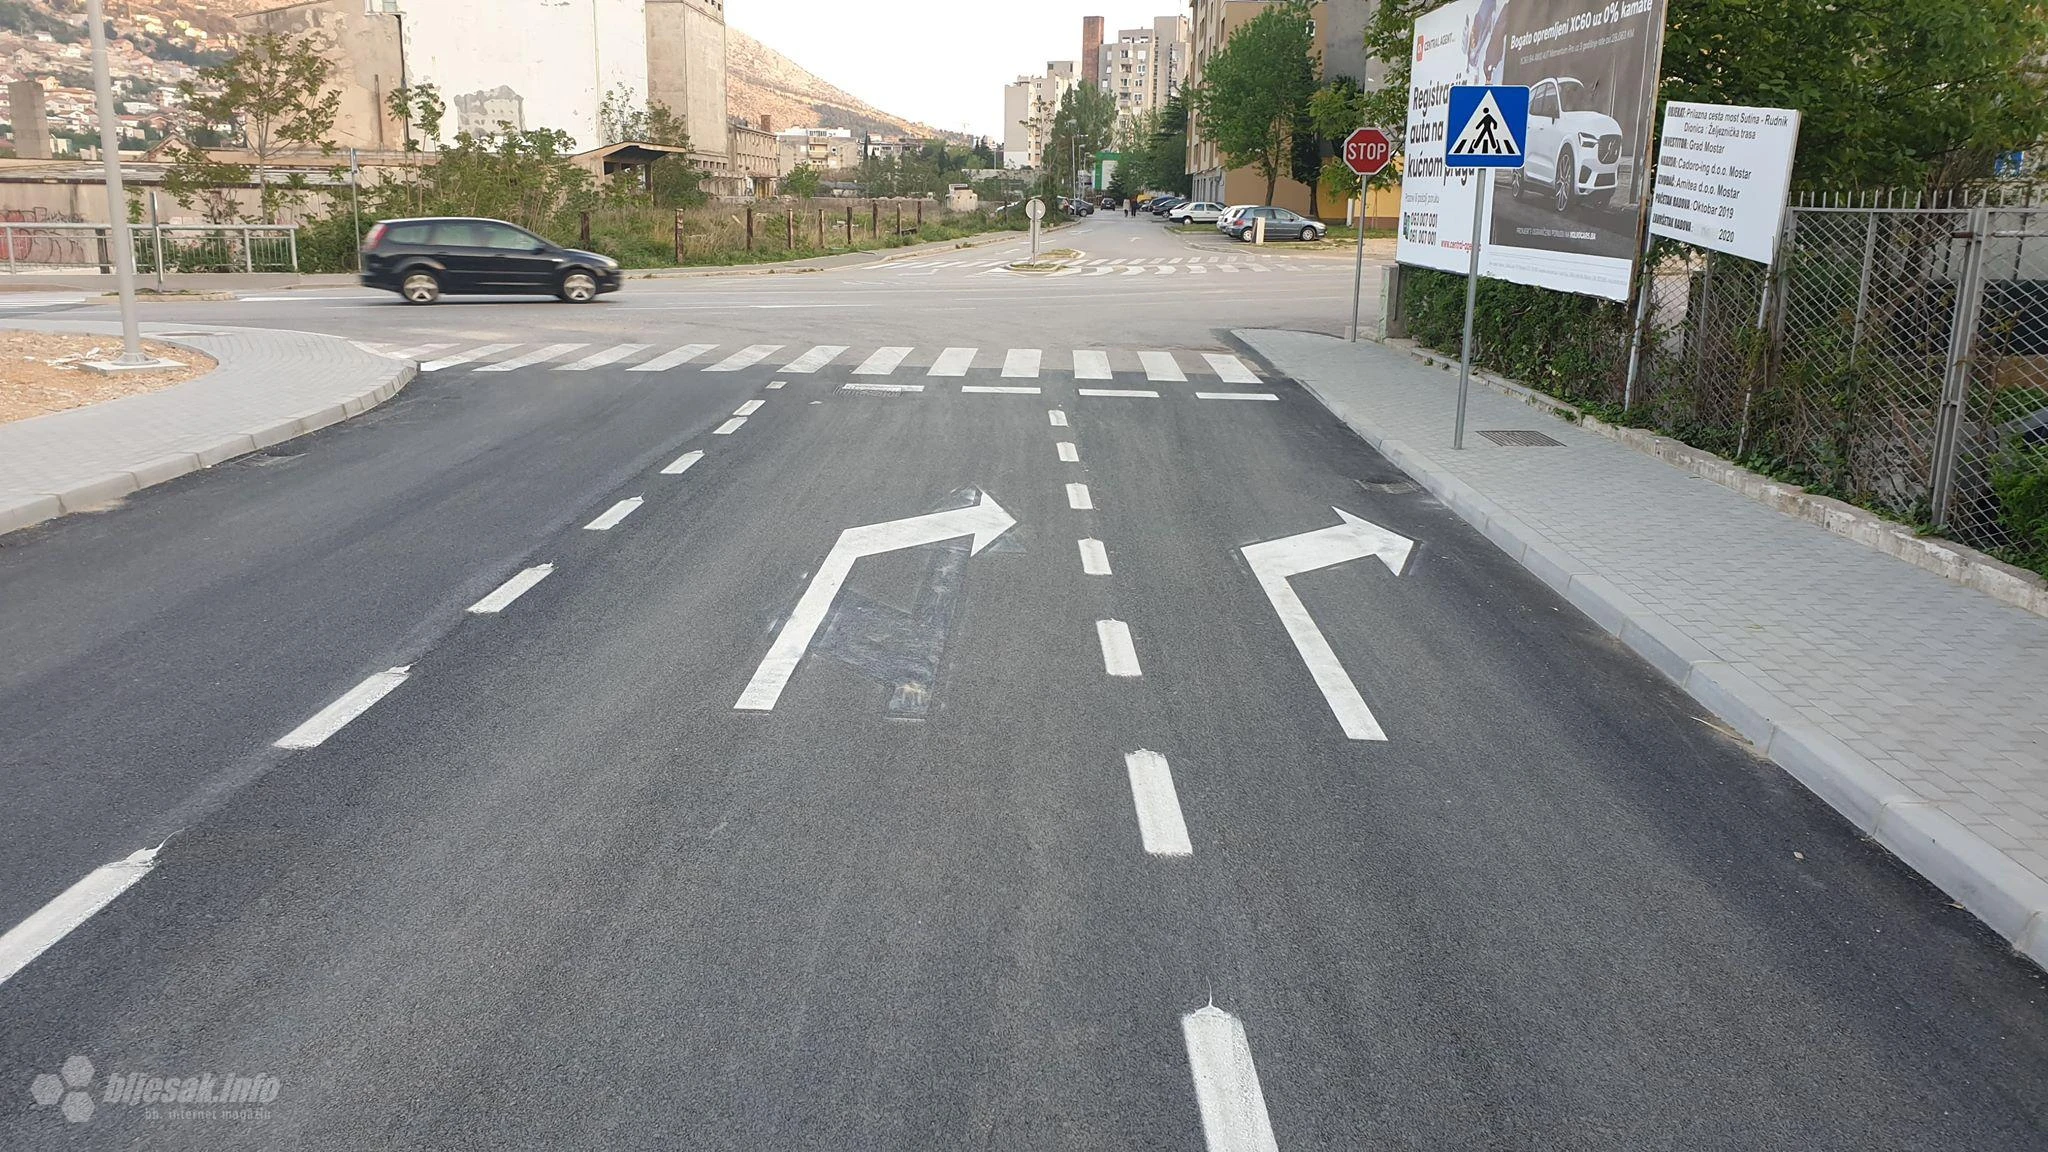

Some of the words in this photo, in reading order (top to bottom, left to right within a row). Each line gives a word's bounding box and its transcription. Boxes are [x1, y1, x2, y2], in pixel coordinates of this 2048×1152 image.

[1511, 32, 1532, 50] Bogato
[1533, 19, 1569, 45] opremljeni
[1570, 12, 1591, 32] XC60
[1593, 13, 1602, 27] uz
[1603, 2, 1619, 24] 0%
[1621, 0, 1652, 18] kamate
[1687, 108, 1708, 120] Prilazna
[1708, 111, 1724, 121] cesta
[1725, 113, 1739, 122] most
[1740, 112, 1760, 124] Sutina
[1765, 114, 1788, 127] Rudnik
[1410, 119, 1430, 144] auta
[1431, 121, 1444, 142] na
[1683, 122, 1704, 134] Dionica
[1708, 122, 1740, 138] Željeznička
[1741, 129, 1756, 139] trasa
[1347, 143, 1387, 160] STOP
[1663, 136, 1688, 149] INVESTITOR:
[1689, 139, 1703, 152] Grad
[1704, 141, 1725, 154] Mostar
[1407, 151, 1442, 178] kućnom
[1678, 158, 1710, 176] Cadoro-ing
[1711, 164, 1728, 176] d.o.o.
[1729, 165, 1752, 180] Mostar
[1676, 177, 1697, 192] Amitea
[1698, 180, 1715, 195] d.o.o.
[1717, 184, 1740, 199] Mostar
[1693, 200, 1718, 216] Oktobar
[1718, 205, 1734, 219] 2019
[1719, 228, 1735, 243] 2020
